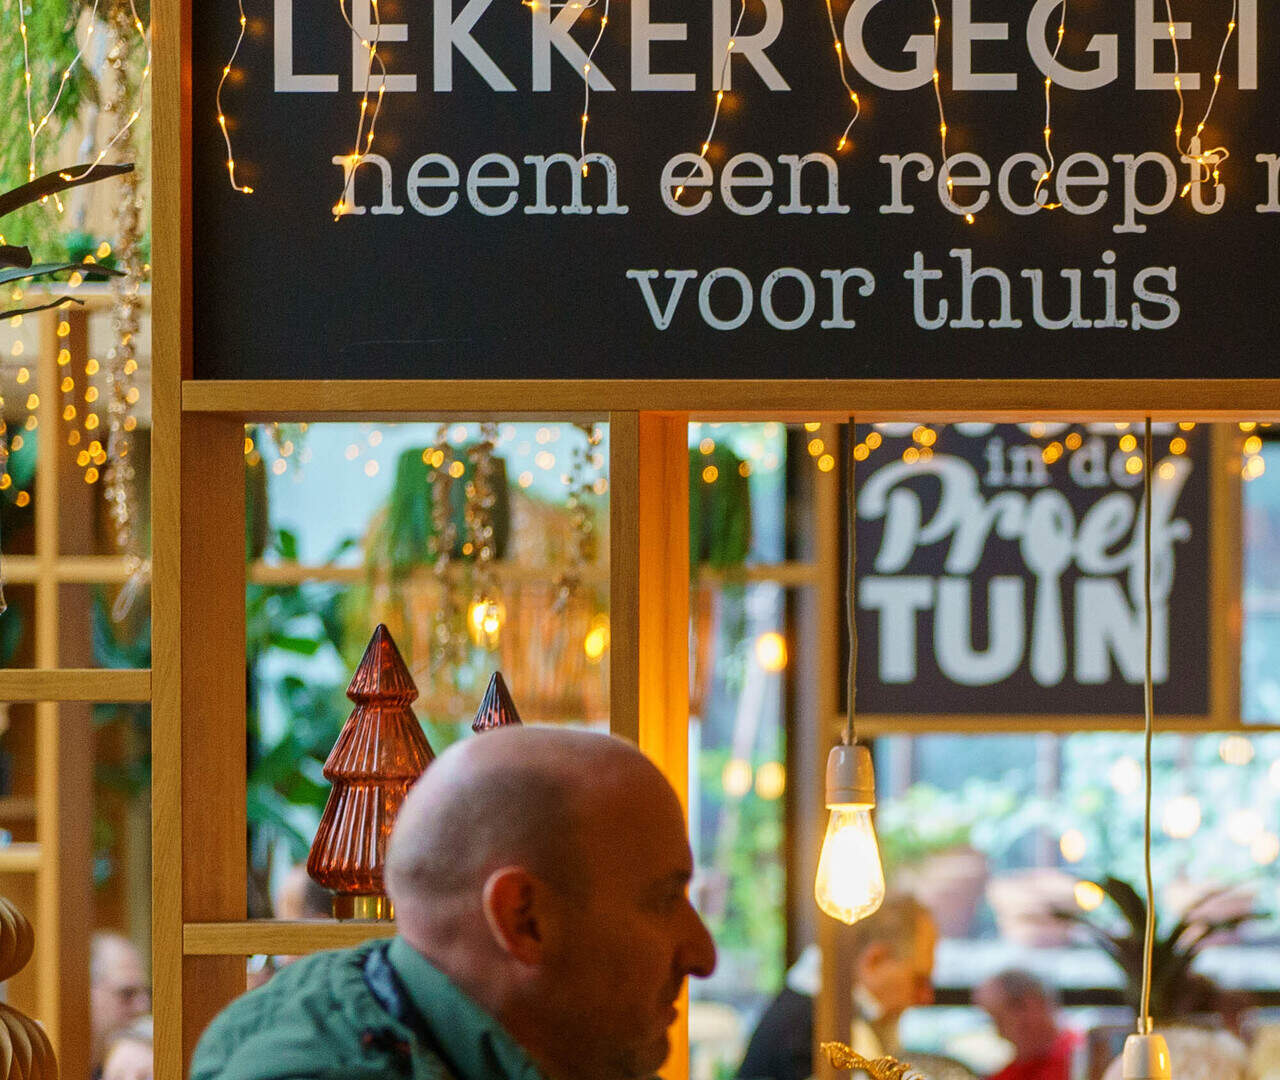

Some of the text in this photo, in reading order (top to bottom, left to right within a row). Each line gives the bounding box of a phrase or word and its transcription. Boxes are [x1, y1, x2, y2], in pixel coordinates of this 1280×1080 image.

[274, 0, 791, 93] LEKKER
[332, 151, 629, 217] neem
[661, 150, 850, 216] een
[880, 136, 1227, 234] recept
[626, 249, 1181, 331] voor thuis
[983, 437, 1052, 487] in
[856, 453, 1193, 605] Proef
[859, 573, 1169, 686] TUIN
